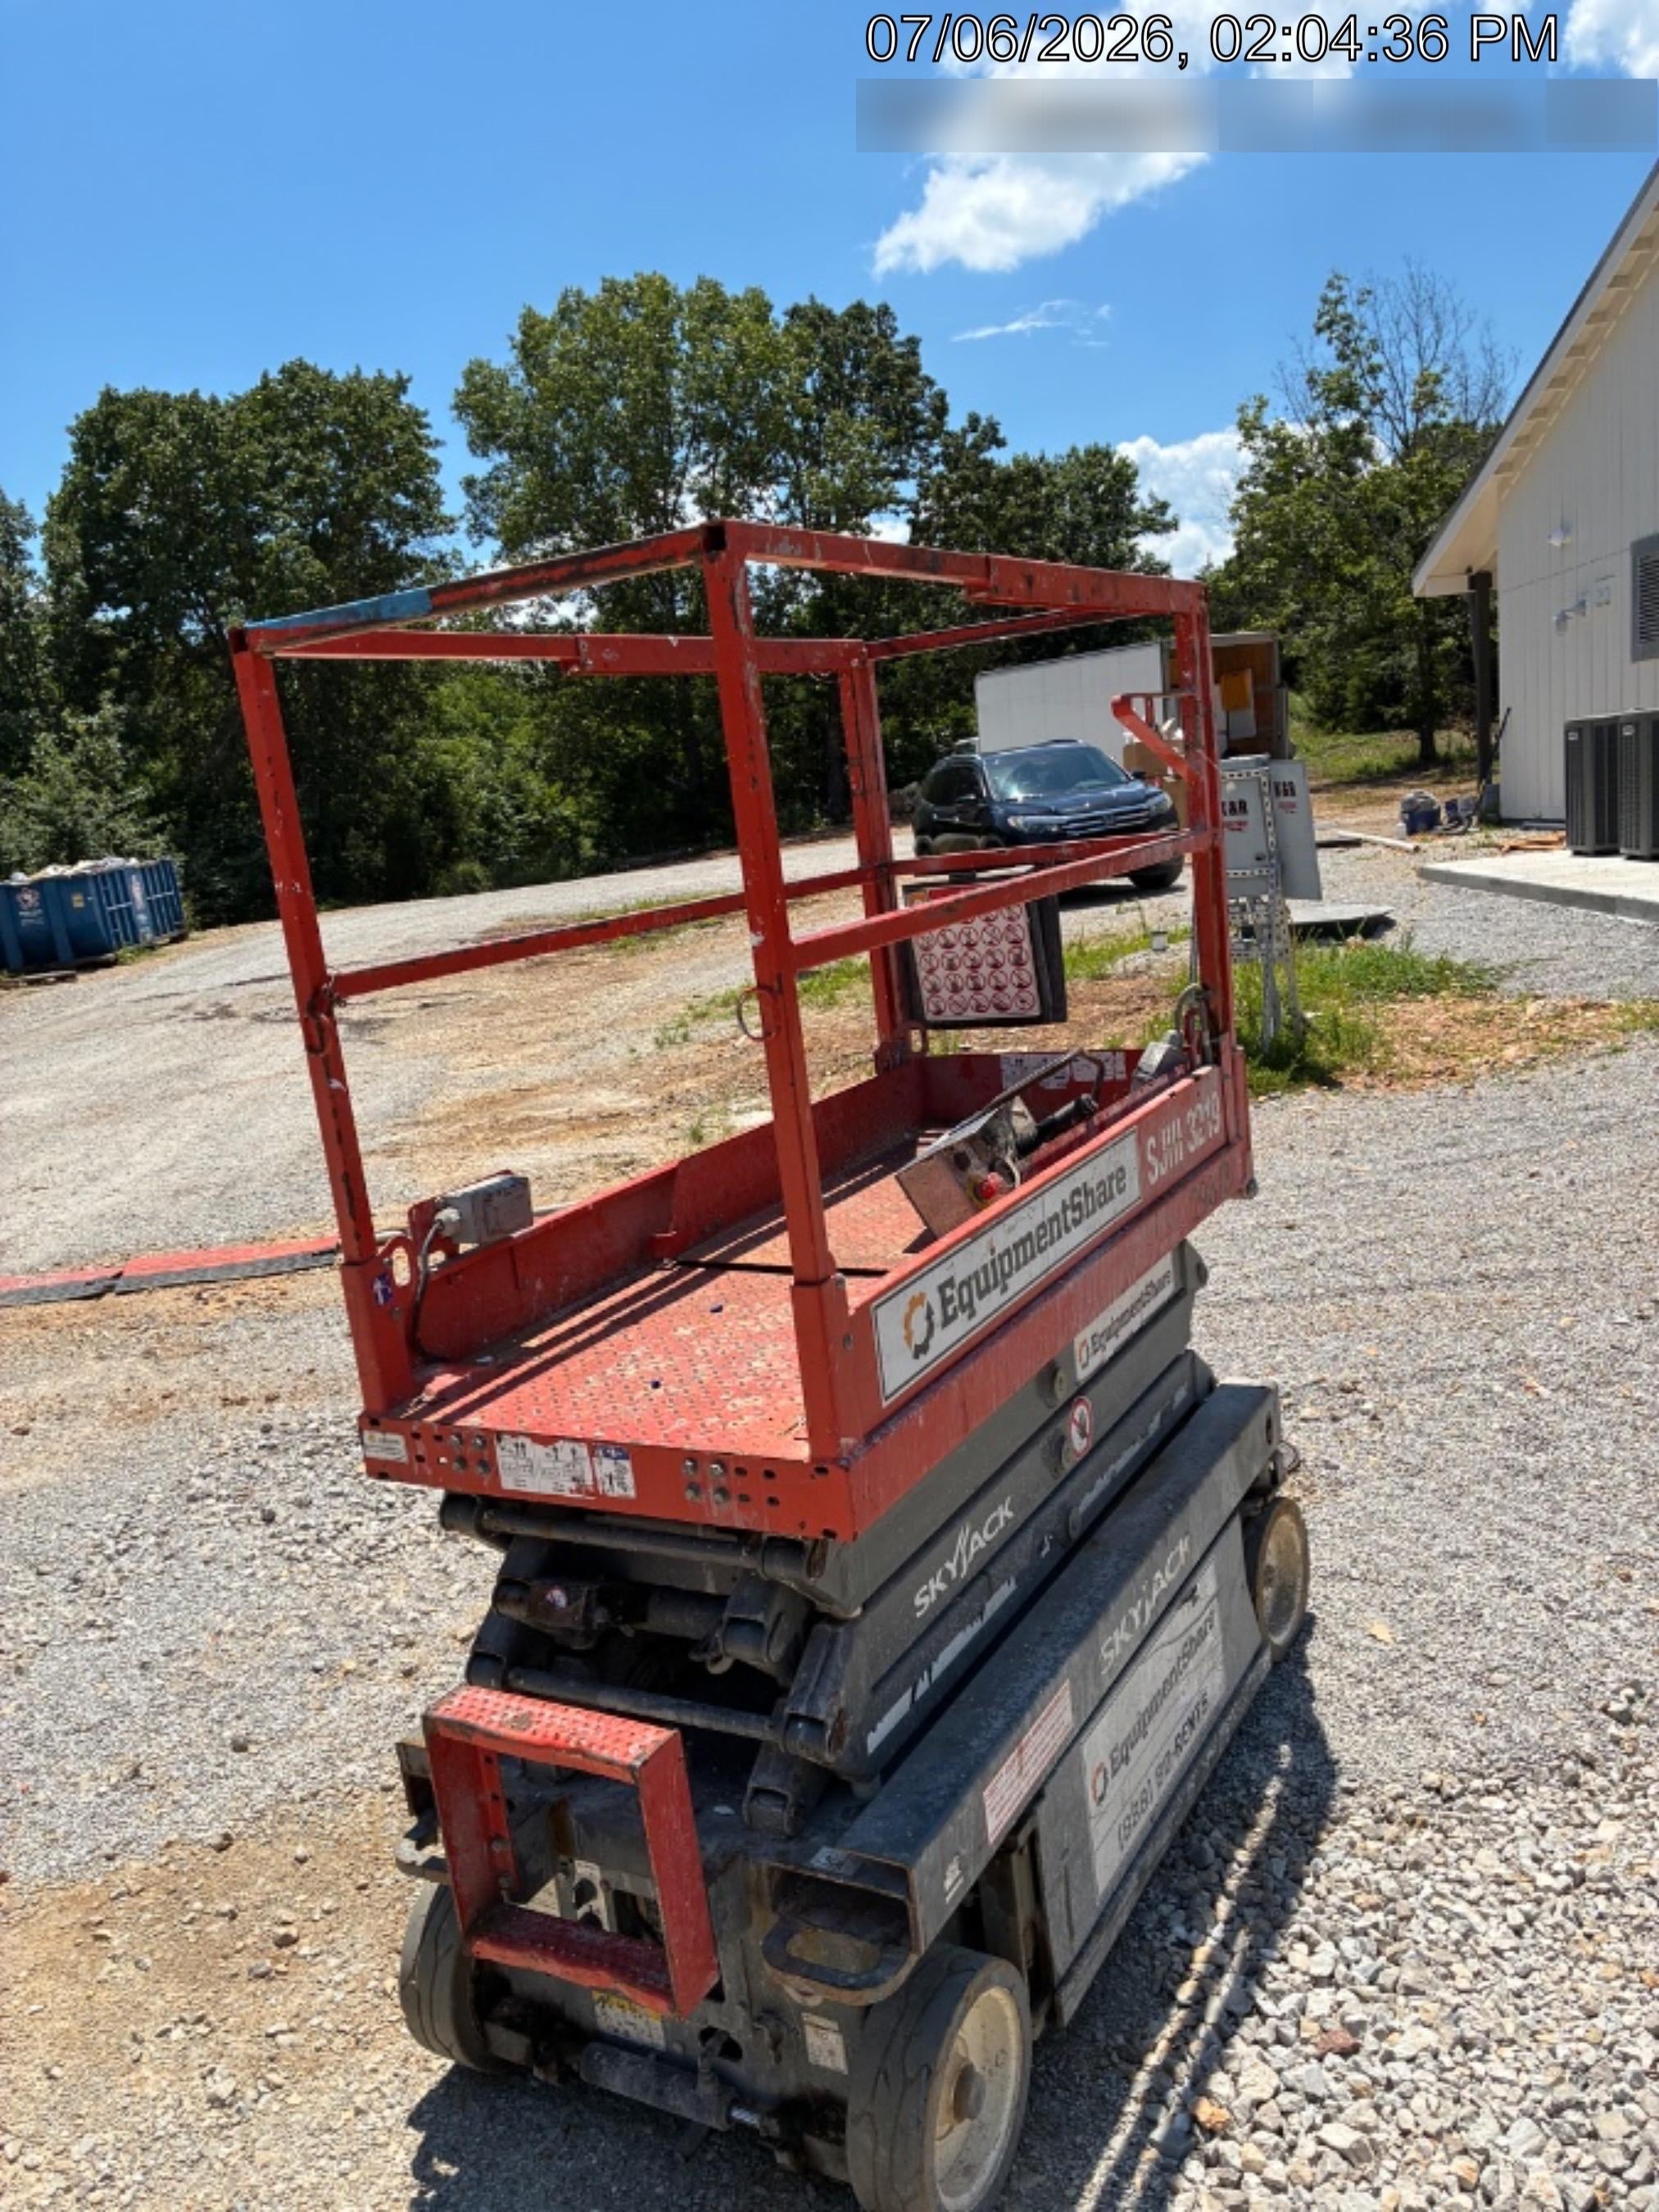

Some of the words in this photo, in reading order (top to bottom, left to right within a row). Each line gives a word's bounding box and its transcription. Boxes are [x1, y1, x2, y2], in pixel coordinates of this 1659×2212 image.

[937, 1164, 1127, 1330] EquipmentShare
[913, 1495, 1014, 1619] SKYJACK
[1100, 1534, 1190, 1675] SKYJACK
[1108, 1608, 1215, 1777] EquipmentShare
